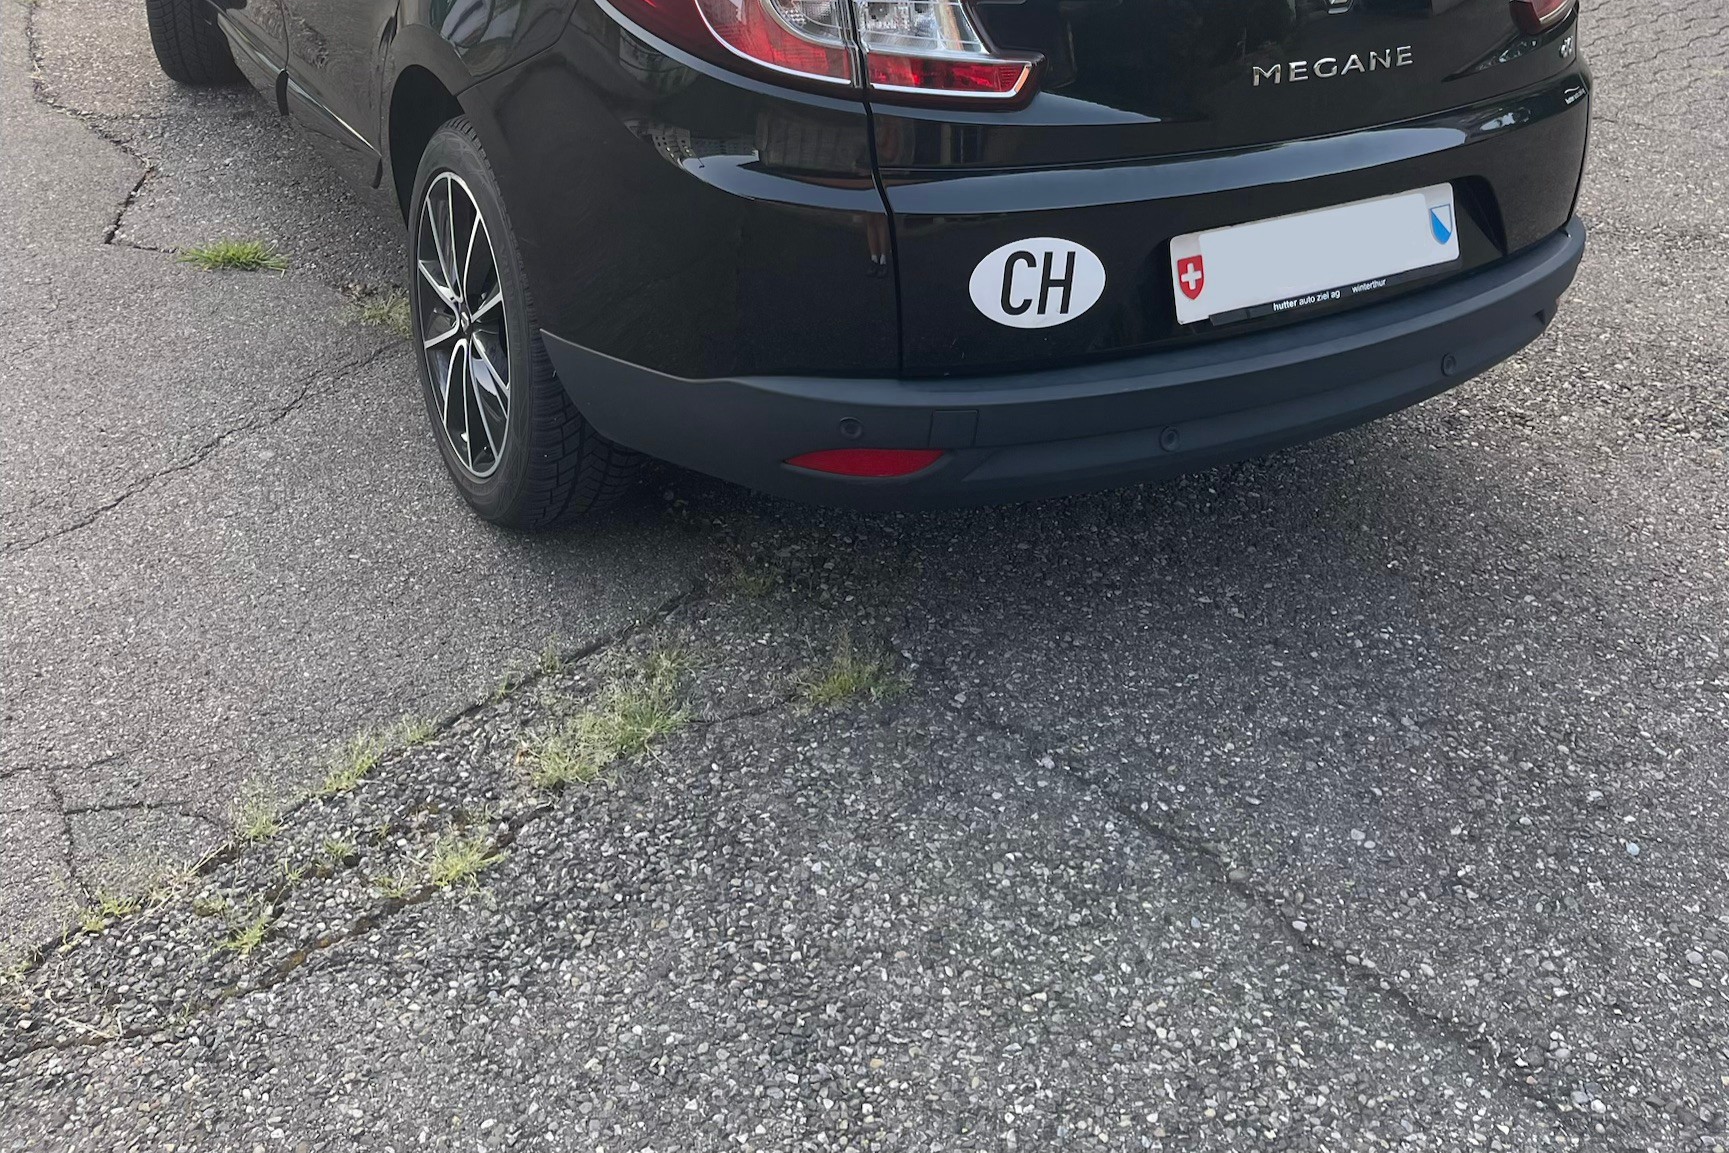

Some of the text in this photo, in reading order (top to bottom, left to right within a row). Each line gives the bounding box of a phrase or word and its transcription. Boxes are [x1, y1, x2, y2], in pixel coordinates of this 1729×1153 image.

[1252, 45, 1414, 87] MEGANE
[1000, 250, 1076, 316] CH
[1351, 278, 1387, 293] winterthur
[1273, 290, 1341, 311] hutter auto ziel ag
